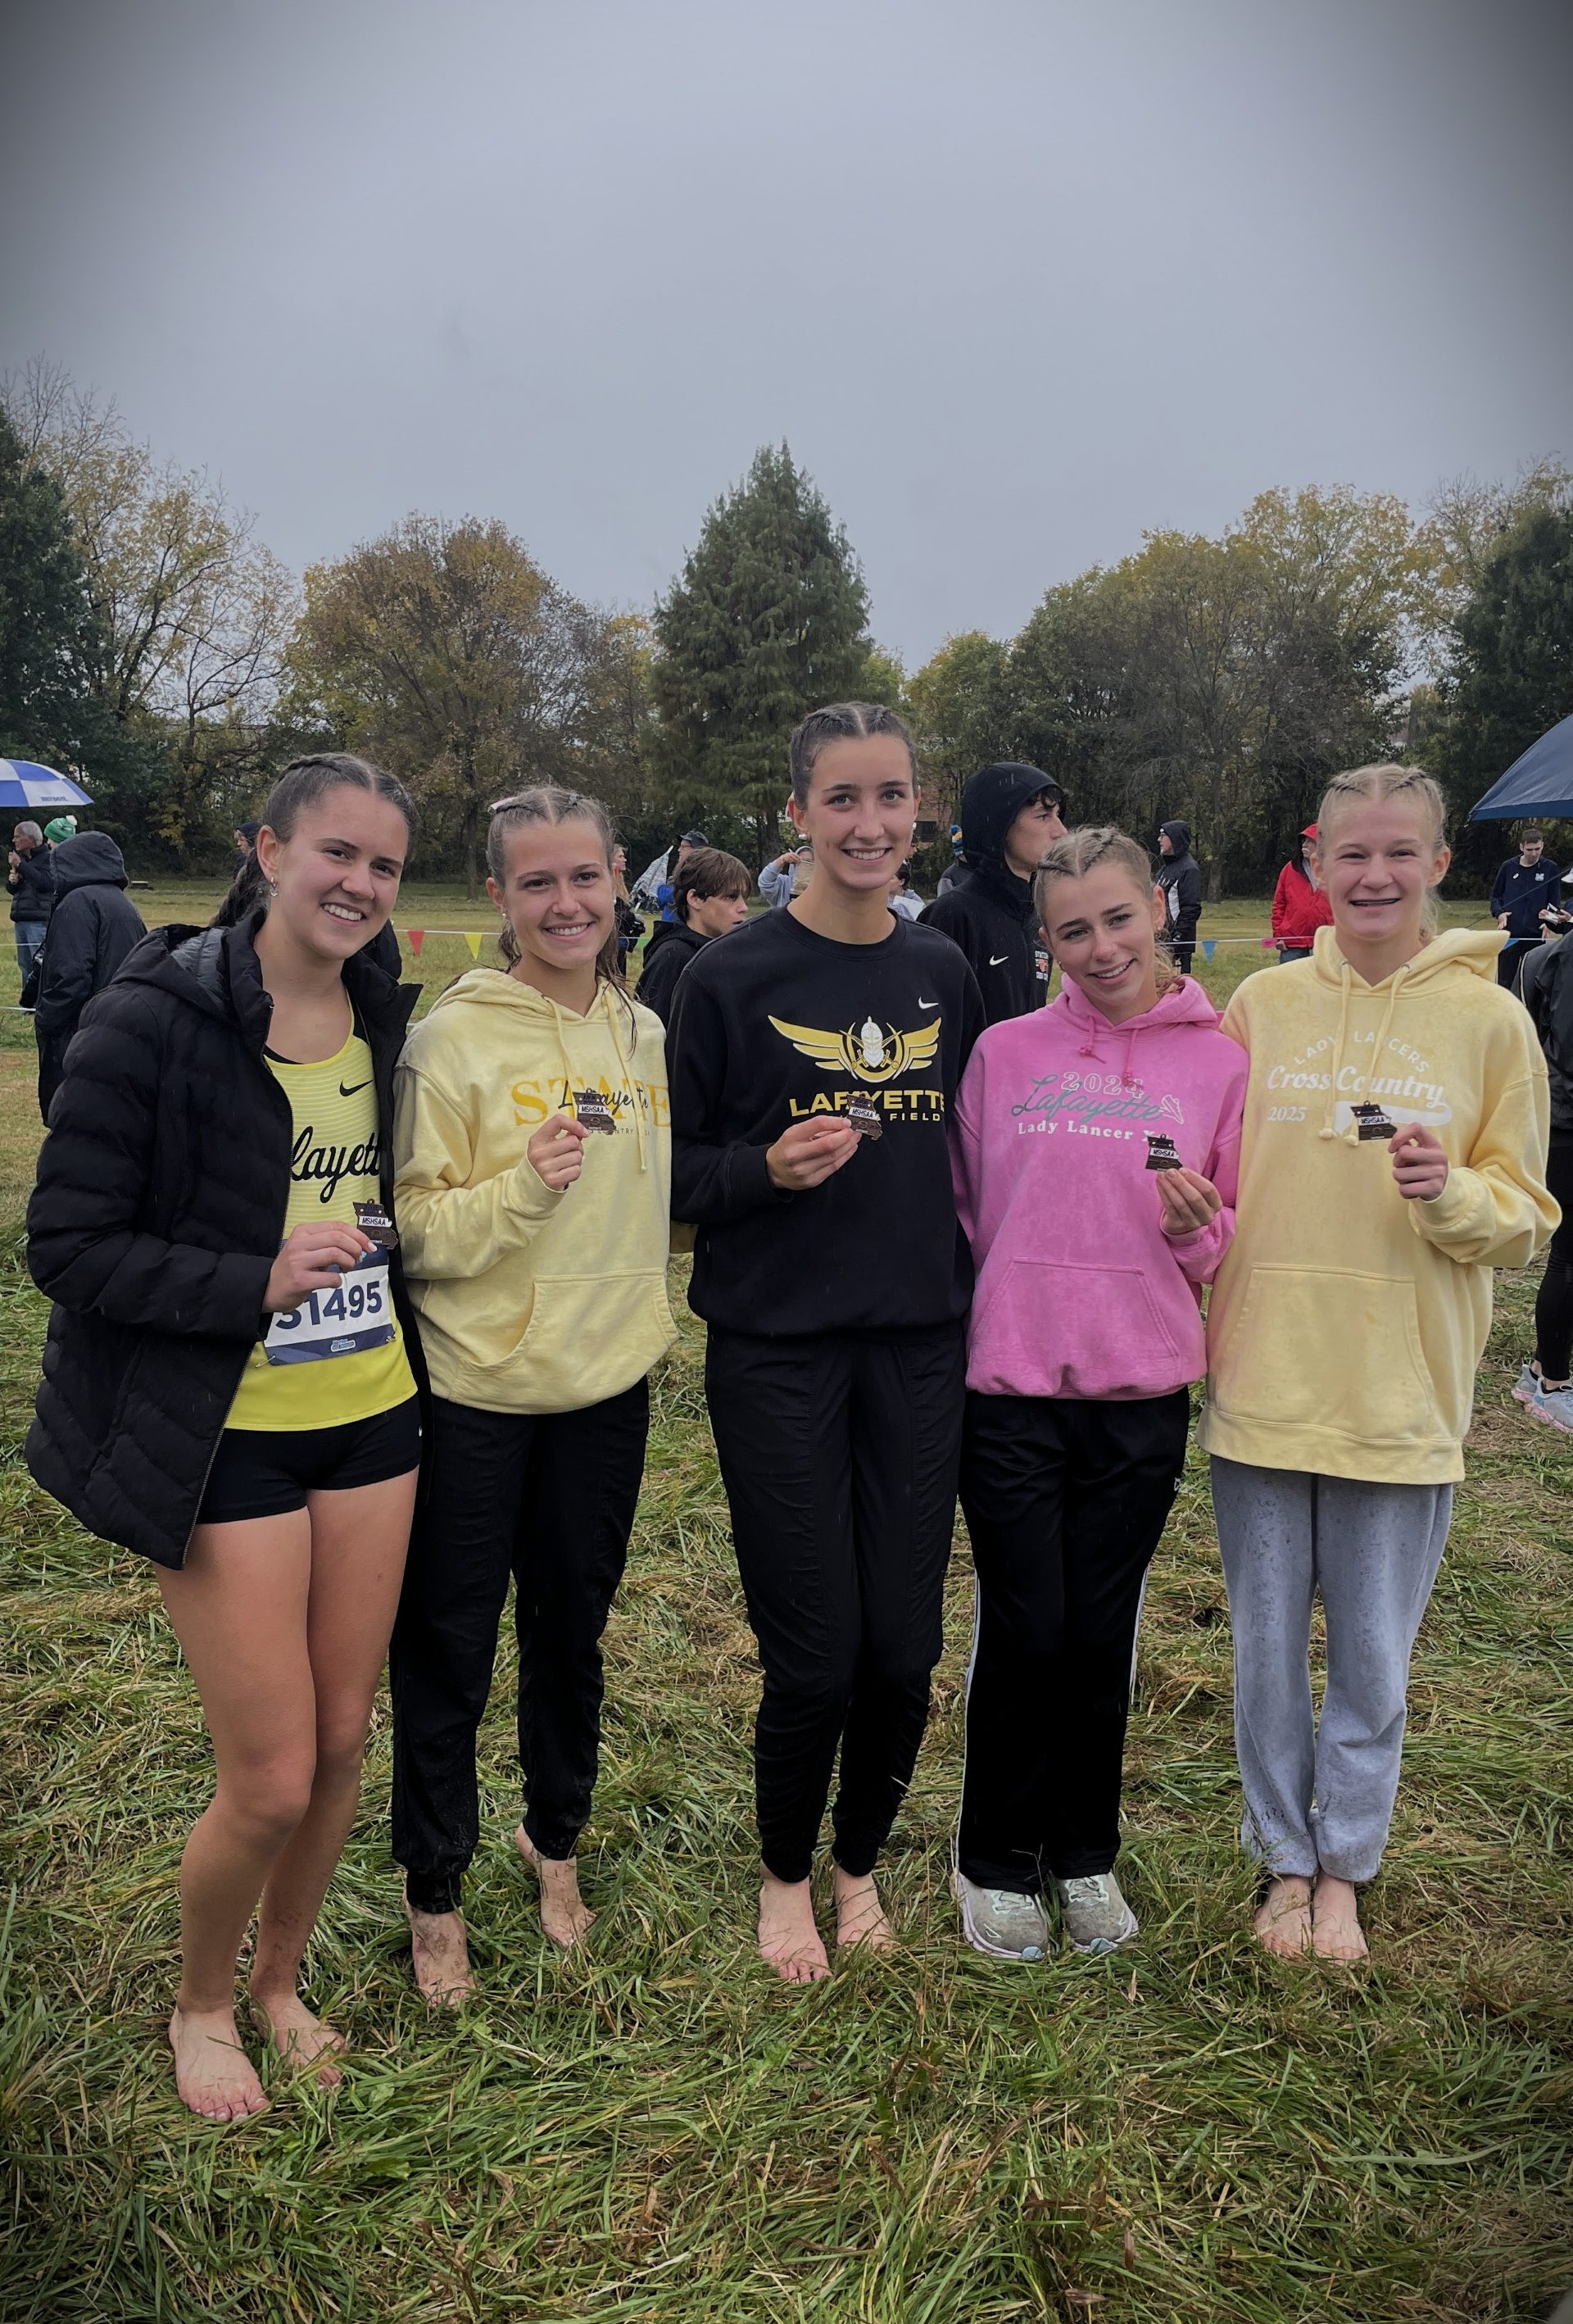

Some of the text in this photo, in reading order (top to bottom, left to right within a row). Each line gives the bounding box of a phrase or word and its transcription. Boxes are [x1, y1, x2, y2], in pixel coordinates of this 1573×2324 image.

[1353, 1030, 1430, 1073] LACERS
[1061, 1072, 1145, 1099] 2024
[1267, 1065, 1331, 1091] Cross
[581, 1105, 605, 1114] MSHSAA
[1011, 1074, 1163, 1124] Lafayette
[889, 1112, 941, 1122] FIELD
[1267, 1106, 1308, 1123] 2025
[1018, 1120, 1058, 1135] Lady
[1067, 1119, 1134, 1140] Lancer
[361, 1217, 386, 1226] MSHSAA
